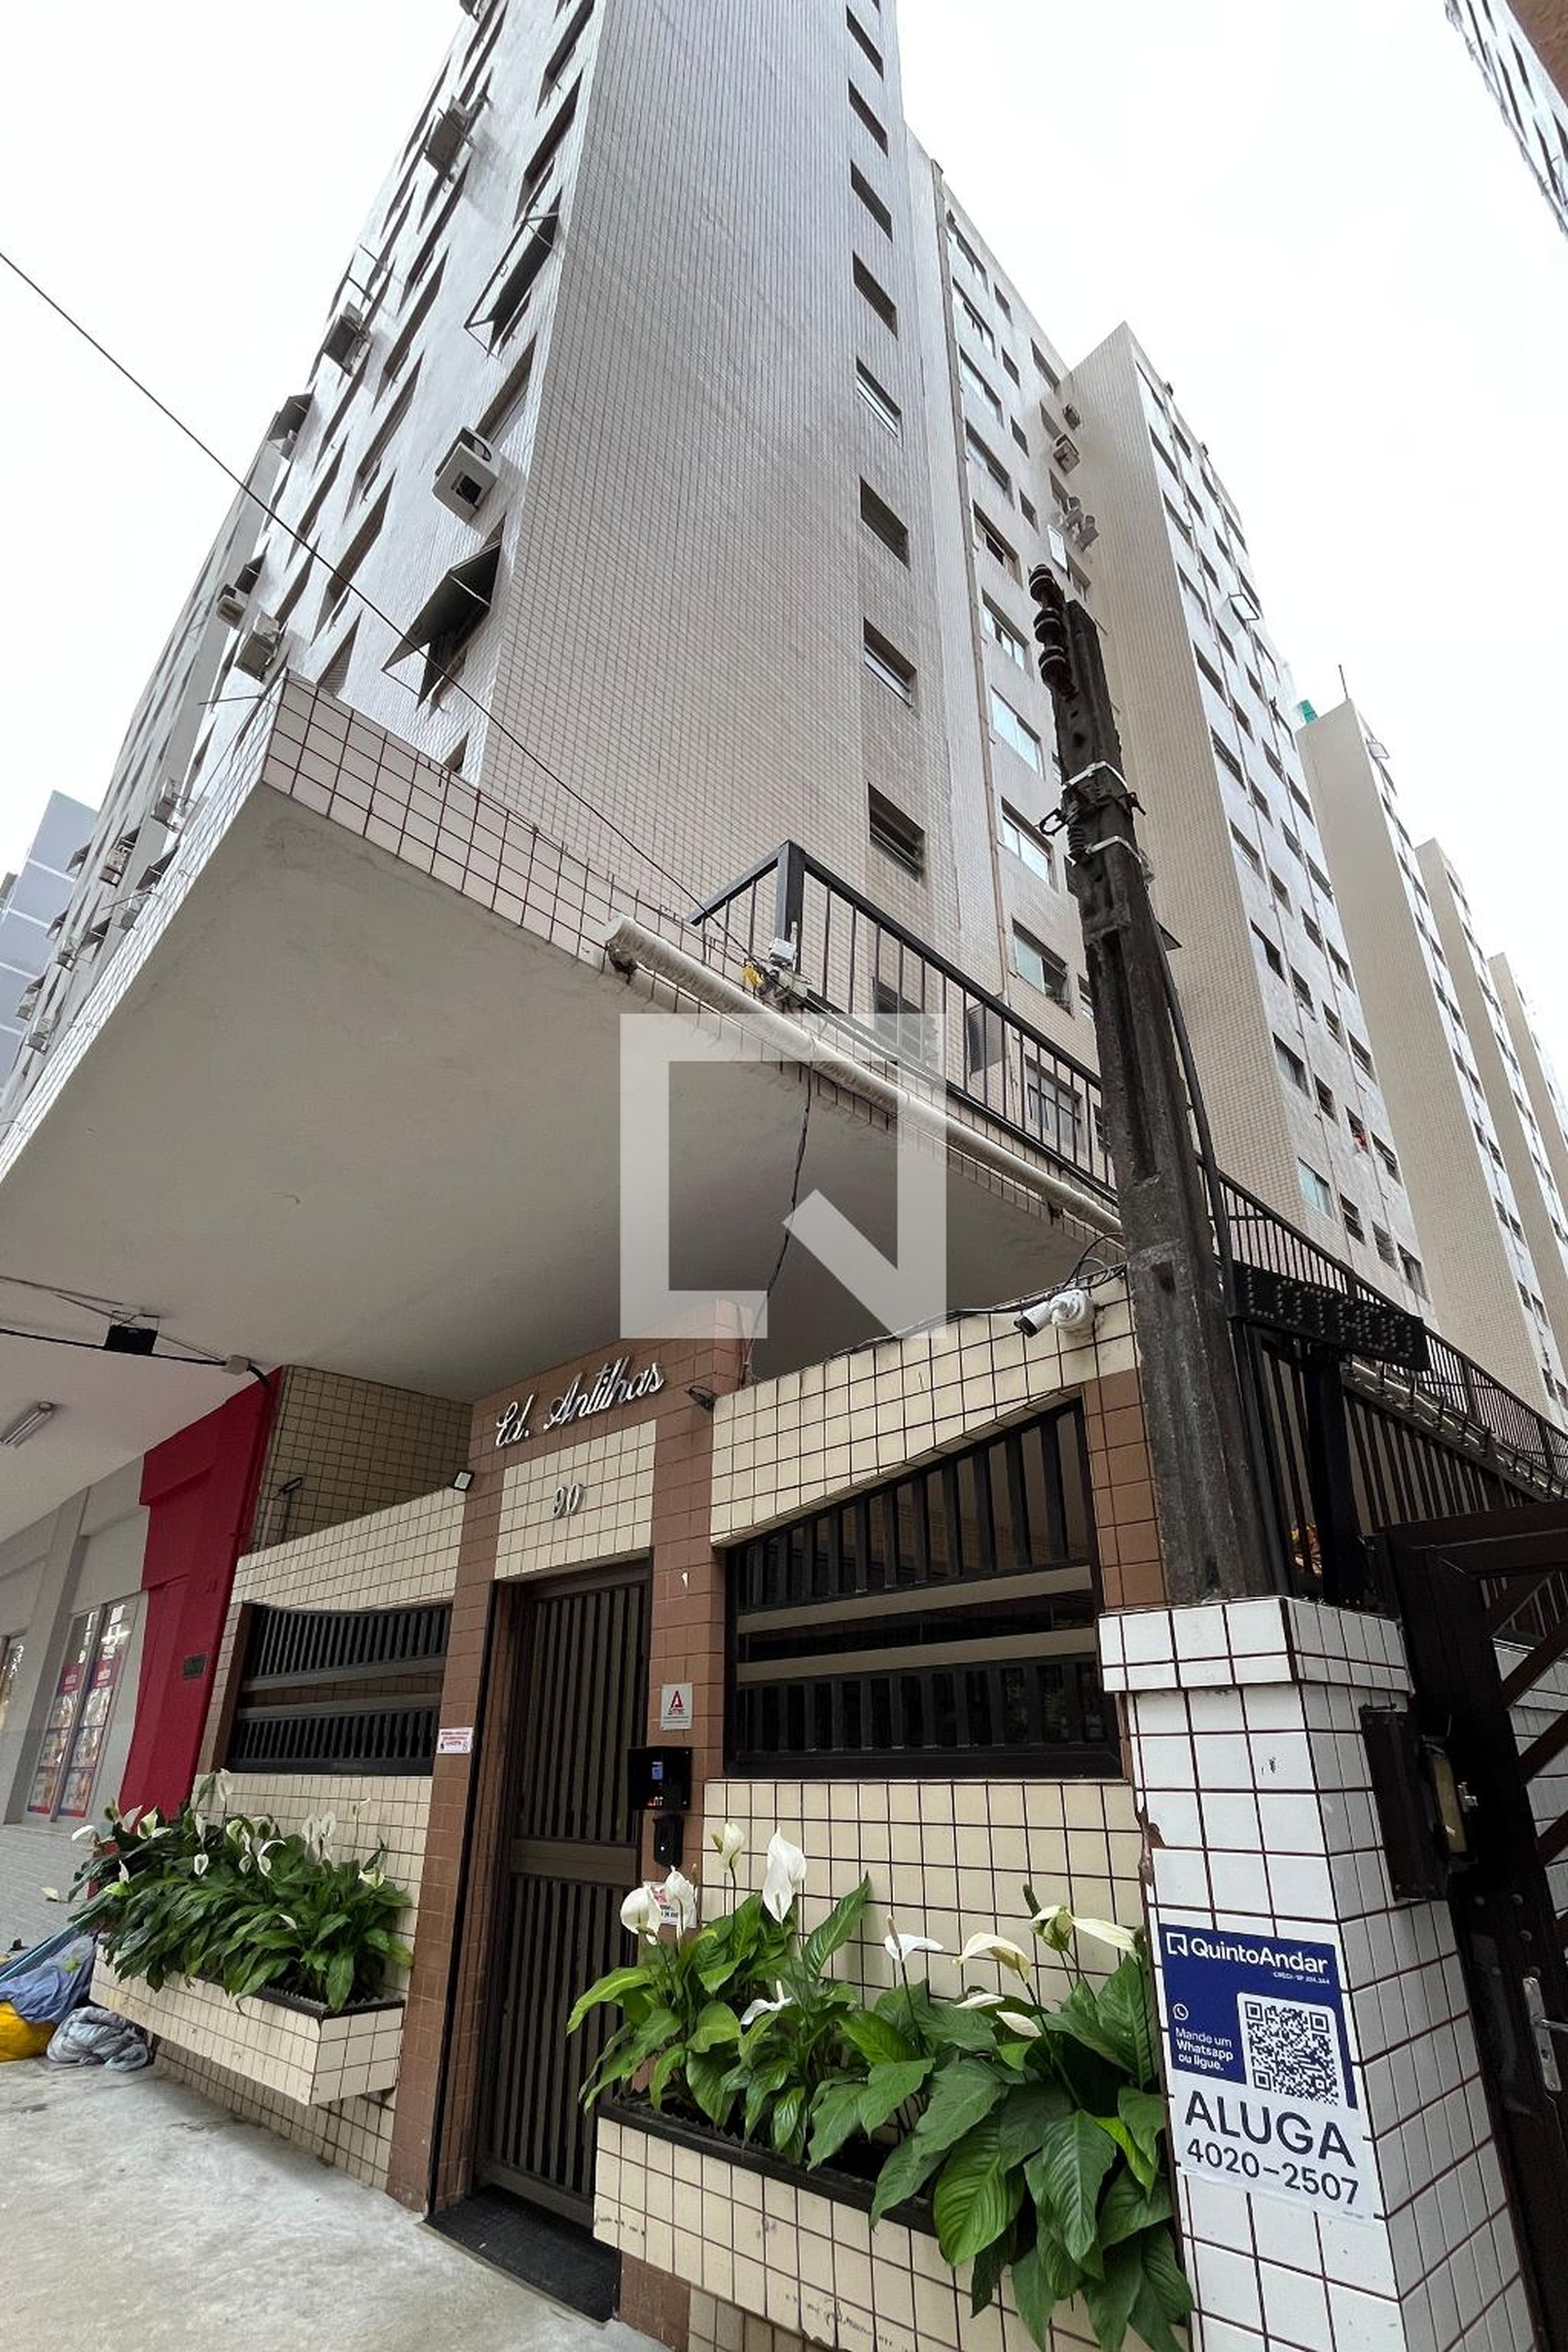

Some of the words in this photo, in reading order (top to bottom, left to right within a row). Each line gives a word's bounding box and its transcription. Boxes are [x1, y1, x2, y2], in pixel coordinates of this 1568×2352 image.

[496, 1393, 534, 1446] Ed.
[543, 1356, 665, 1430] Antilhas
[1191, 1938, 1328, 1974] QuintoAndar
[1176, 2027, 1213, 2045] Mande
[1214, 2037, 1232, 2047] um
[1176, 2039, 1234, 2062] Whatsapp
[1178, 2054, 1192, 2064] ou
[1194, 2055, 1224, 2071] ligue.
[1185, 2090, 1356, 2168] ALUGA
[1187, 2138, 1360, 2205] 4020-2507
